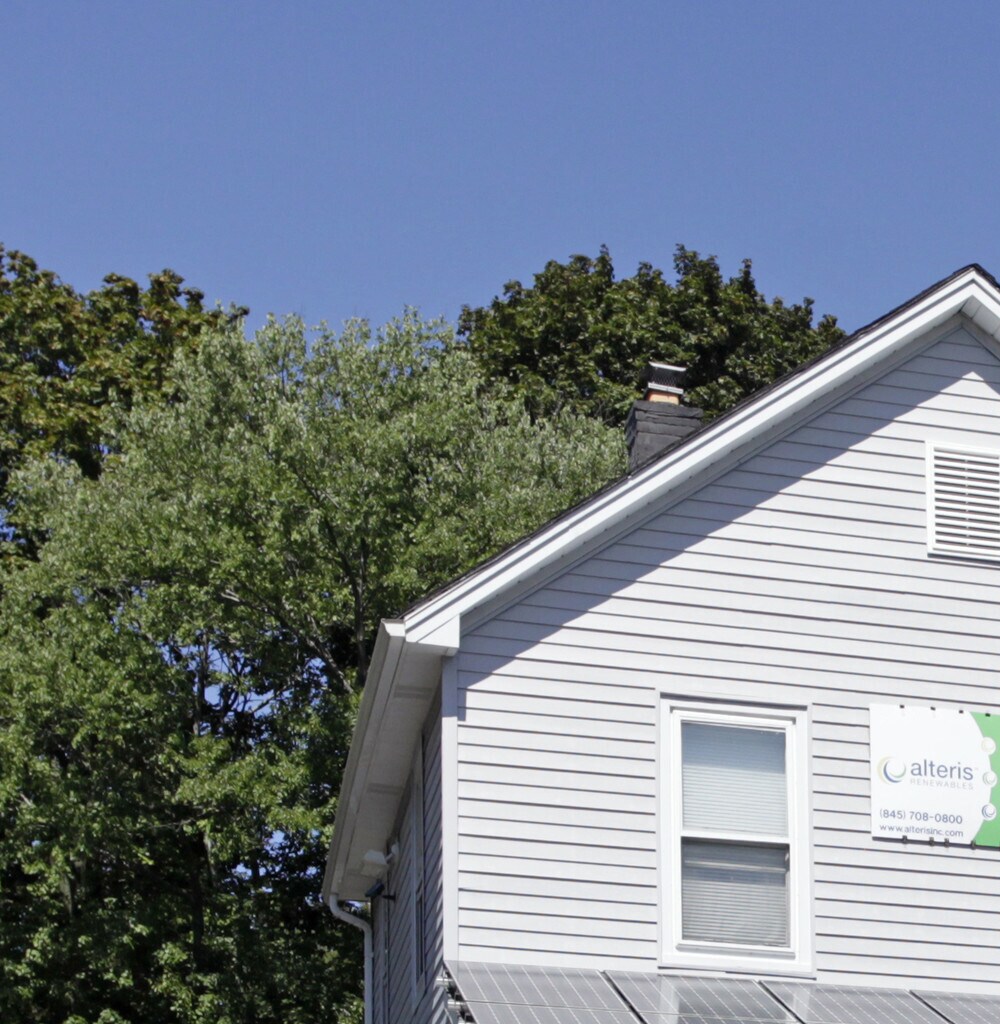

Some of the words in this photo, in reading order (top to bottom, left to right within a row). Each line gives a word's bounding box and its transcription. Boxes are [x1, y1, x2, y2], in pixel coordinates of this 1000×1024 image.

[910, 758, 974, 781] alteris
[910, 778, 974, 790] RENEWABLES
[879, 808, 906, 820] (845)
[909, 811, 963, 825] 708-0800
[879, 824, 964, 837] www.alterisinc.com
